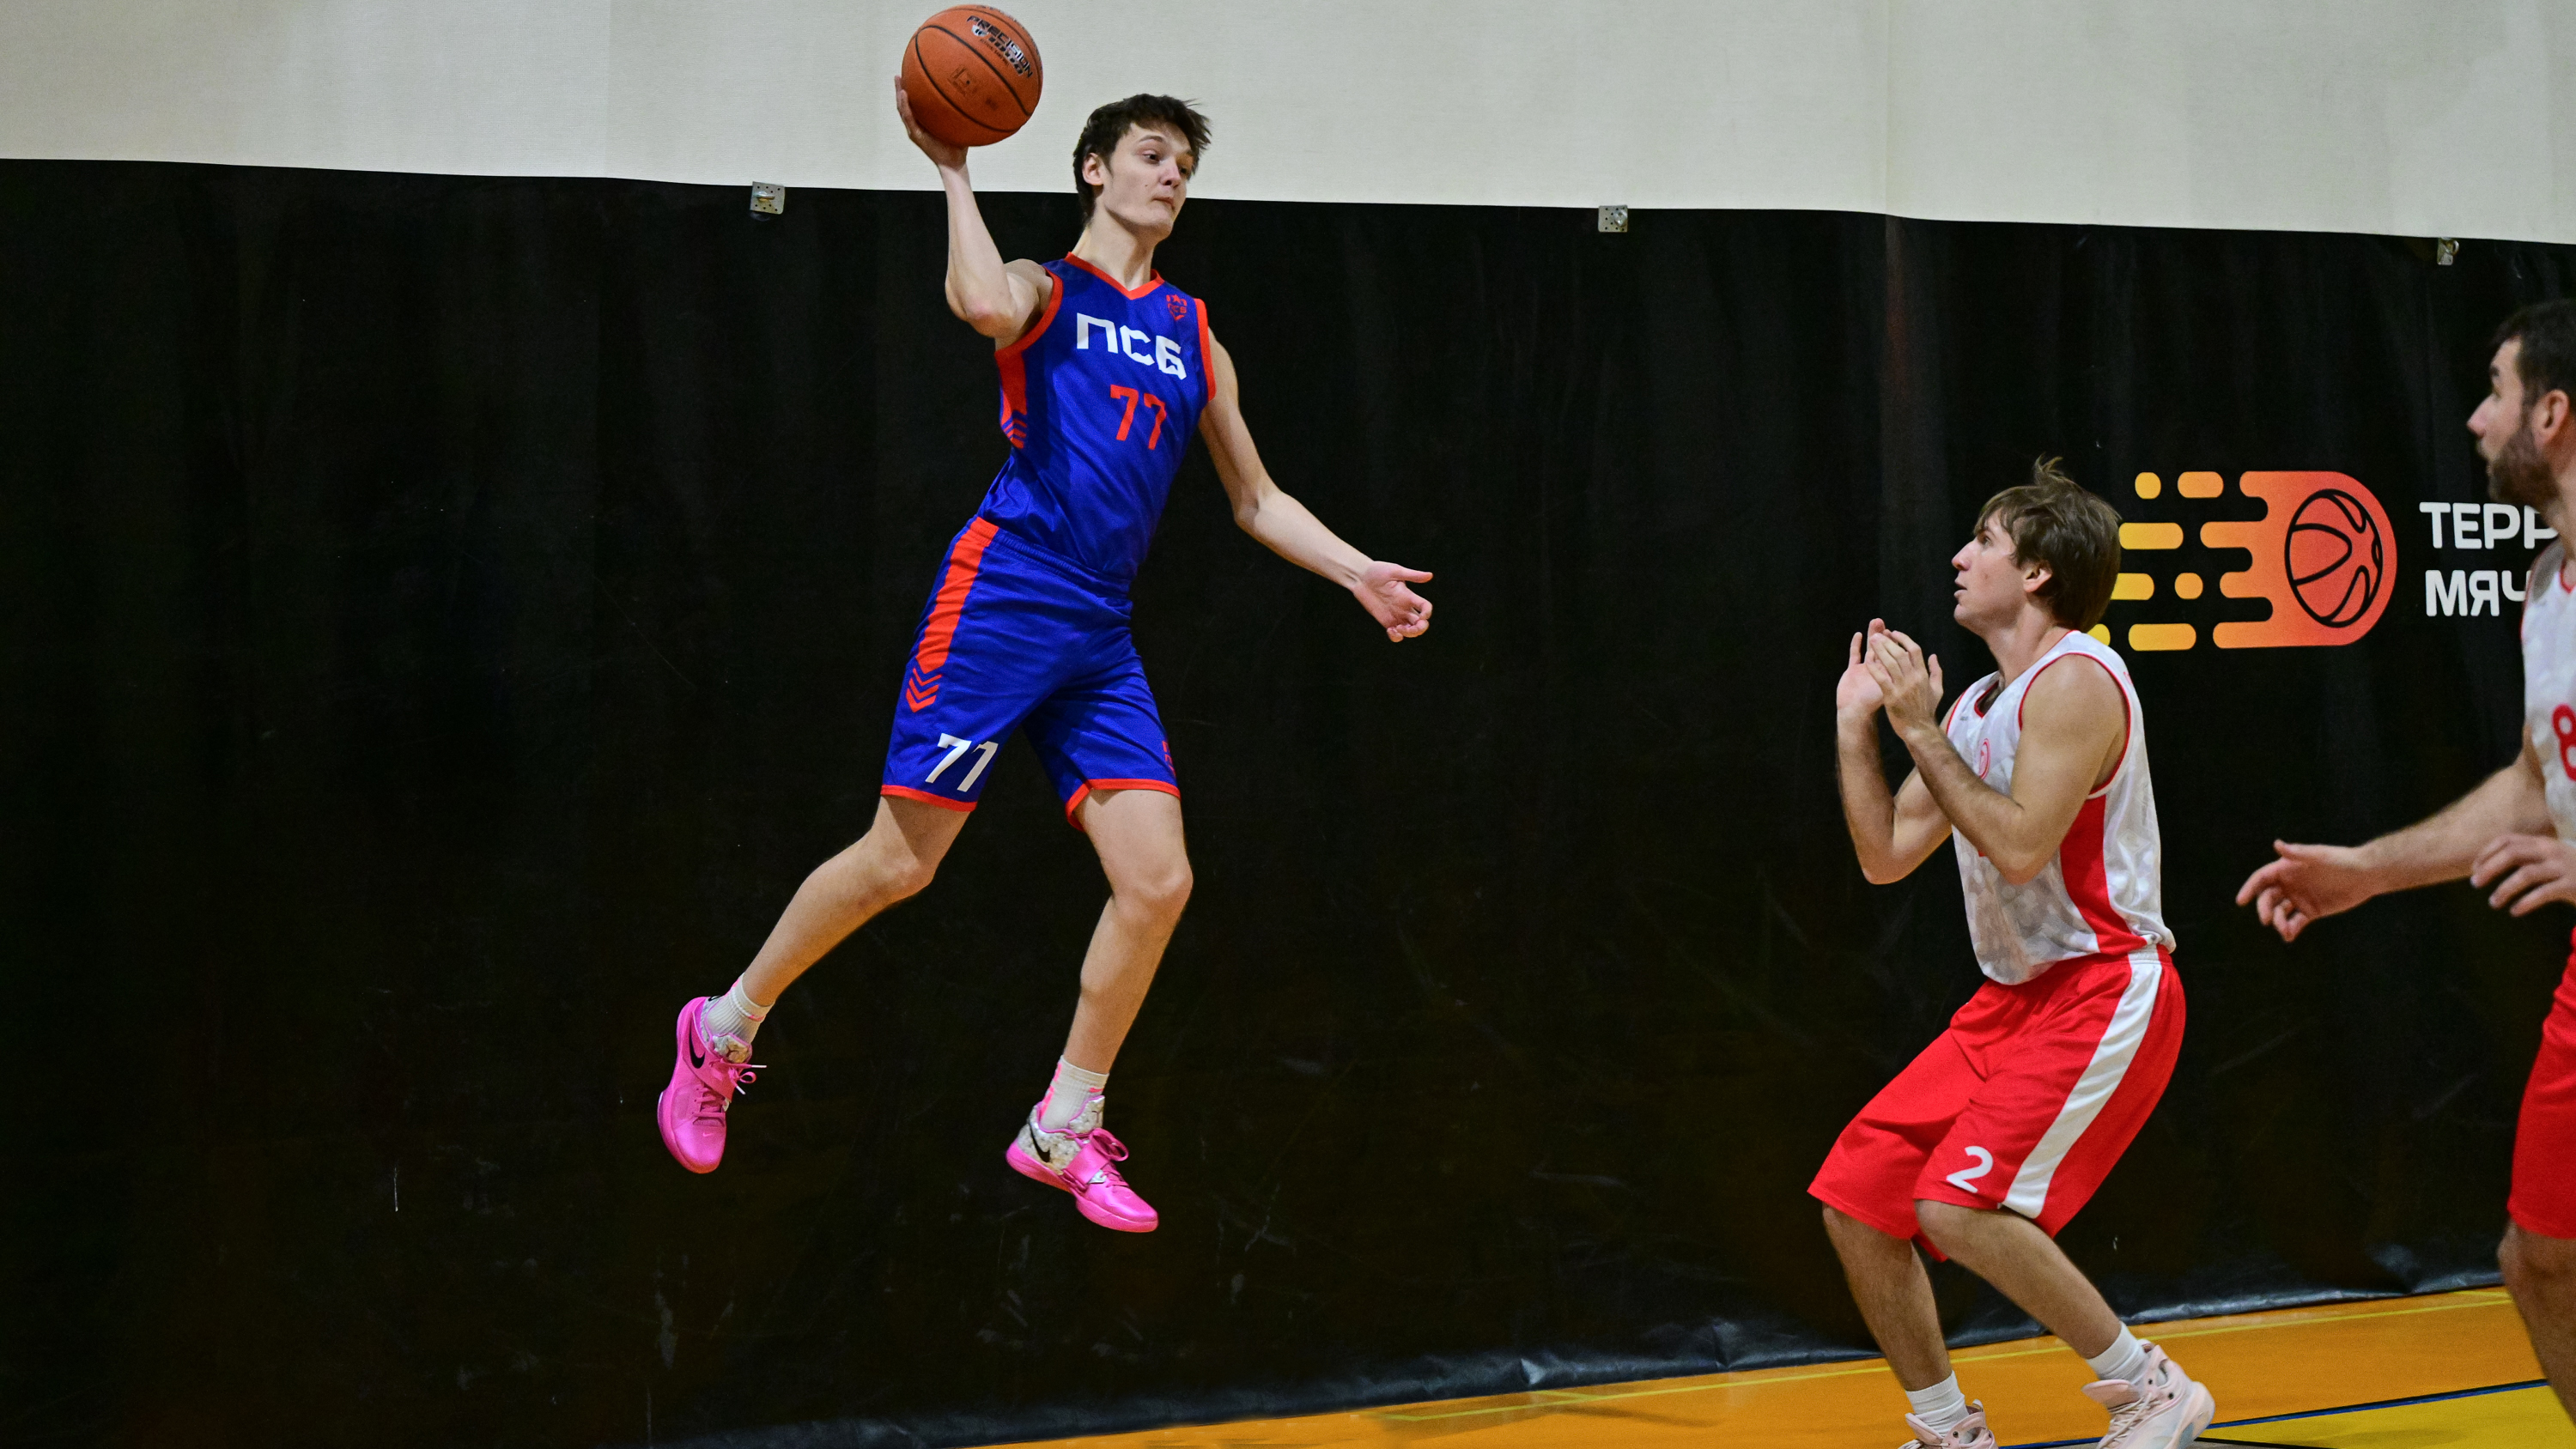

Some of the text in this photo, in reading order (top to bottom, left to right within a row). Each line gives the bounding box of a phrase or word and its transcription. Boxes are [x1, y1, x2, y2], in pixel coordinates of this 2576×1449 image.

[1076, 312, 1188, 380] ПСБ
[1110, 384, 1167, 451] 77
[1946, 1145, 1994, 1193] 2
